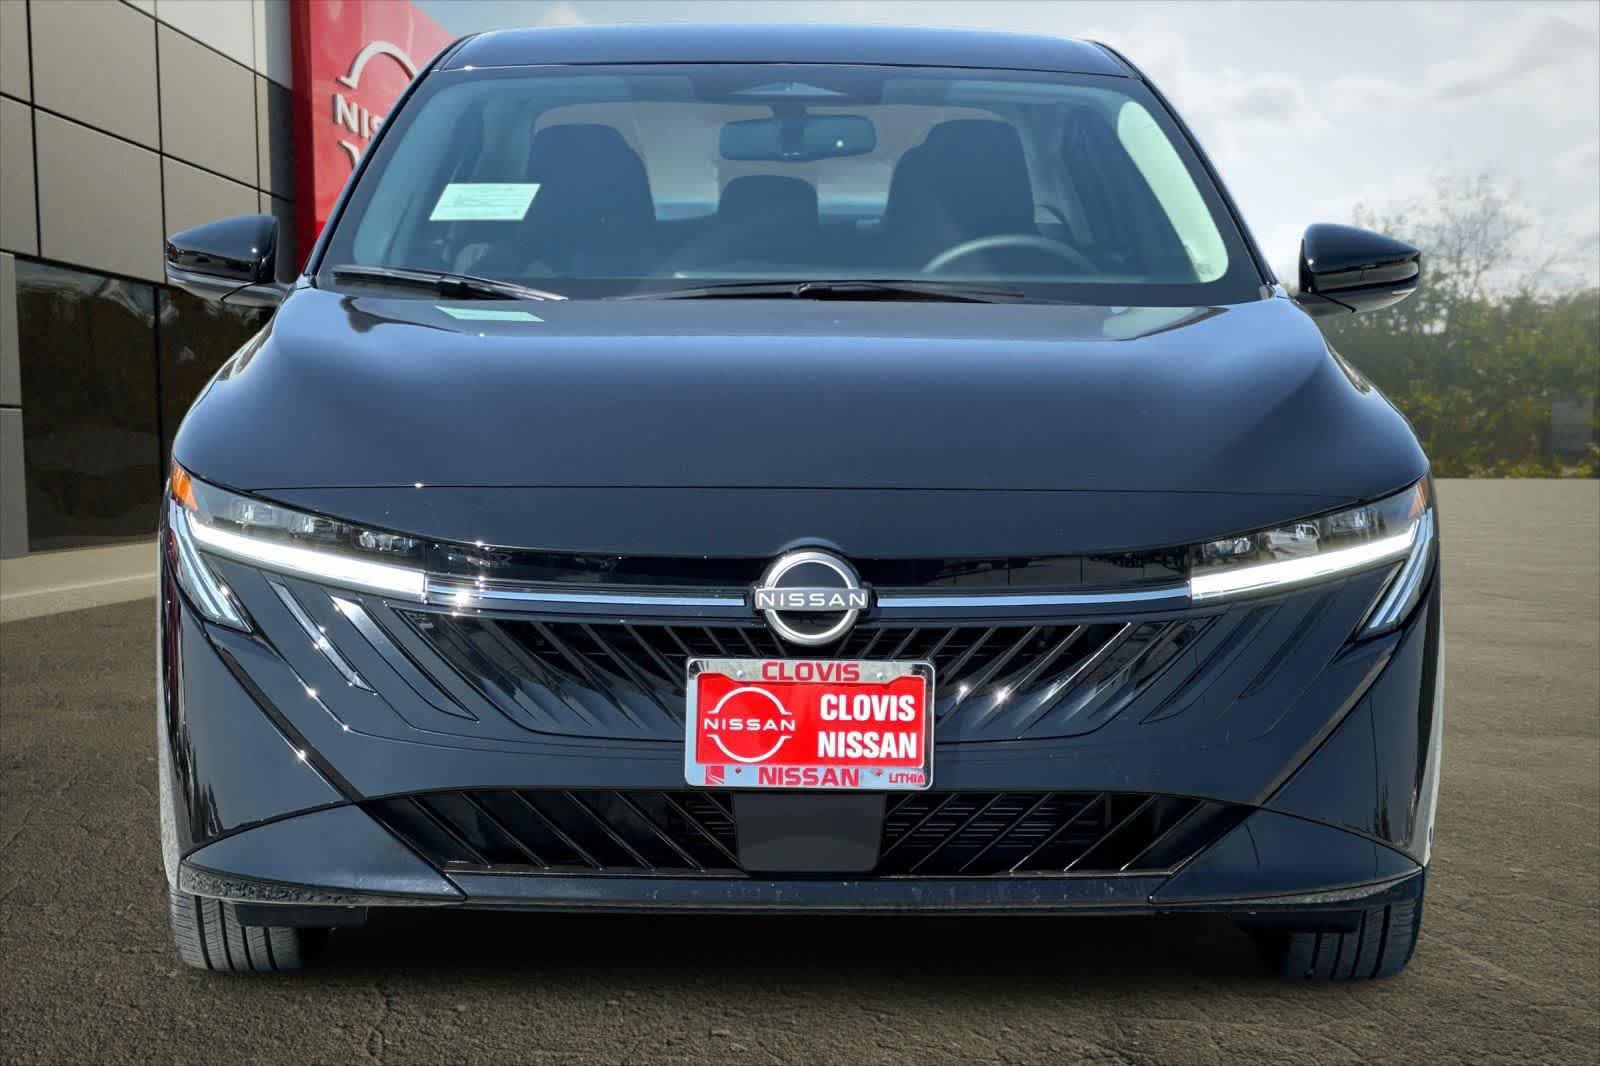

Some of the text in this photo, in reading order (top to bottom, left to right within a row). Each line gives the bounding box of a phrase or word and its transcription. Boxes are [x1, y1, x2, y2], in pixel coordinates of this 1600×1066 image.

[759, 592, 865, 607] NISSAN
[762, 662, 860, 682] CLOVIS
[820, 694, 916, 722] CLOVIS
[703, 718, 797, 732] NISSAN
[817, 731, 918, 759] NISSAN
[758, 767, 859, 787] NISSAN
[888, 773, 925, 784] LITHIA
